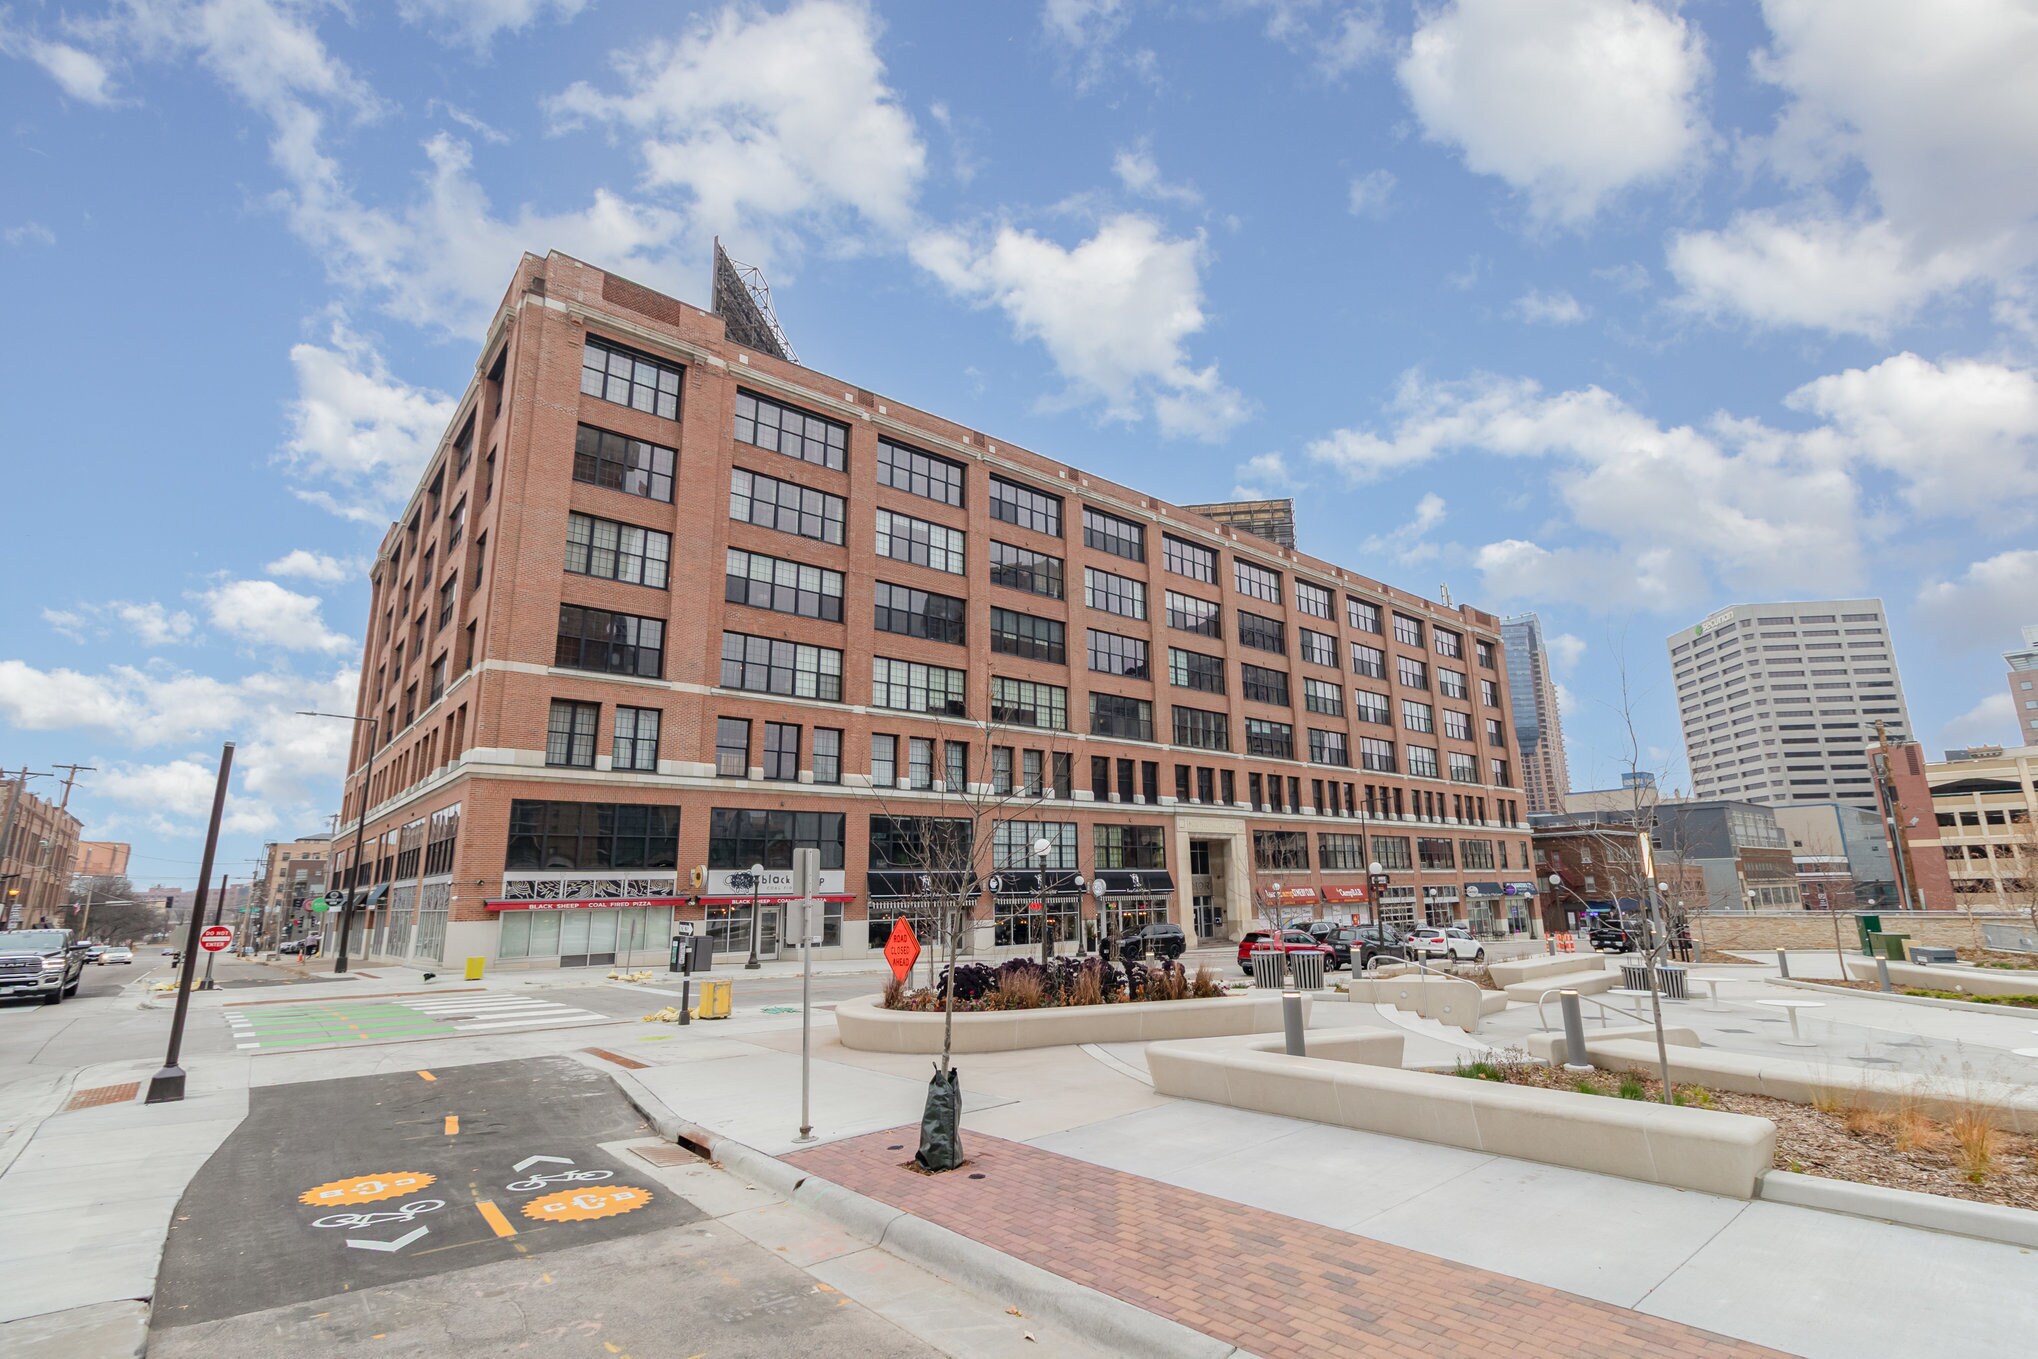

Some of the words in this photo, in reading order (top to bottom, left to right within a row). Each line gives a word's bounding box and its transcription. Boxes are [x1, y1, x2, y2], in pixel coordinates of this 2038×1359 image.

[761, 874, 791, 884] black
[893, 934, 908, 943] ROAD
[890, 945, 910, 955] CLOSED
[893, 957, 910, 967] AHEAD
